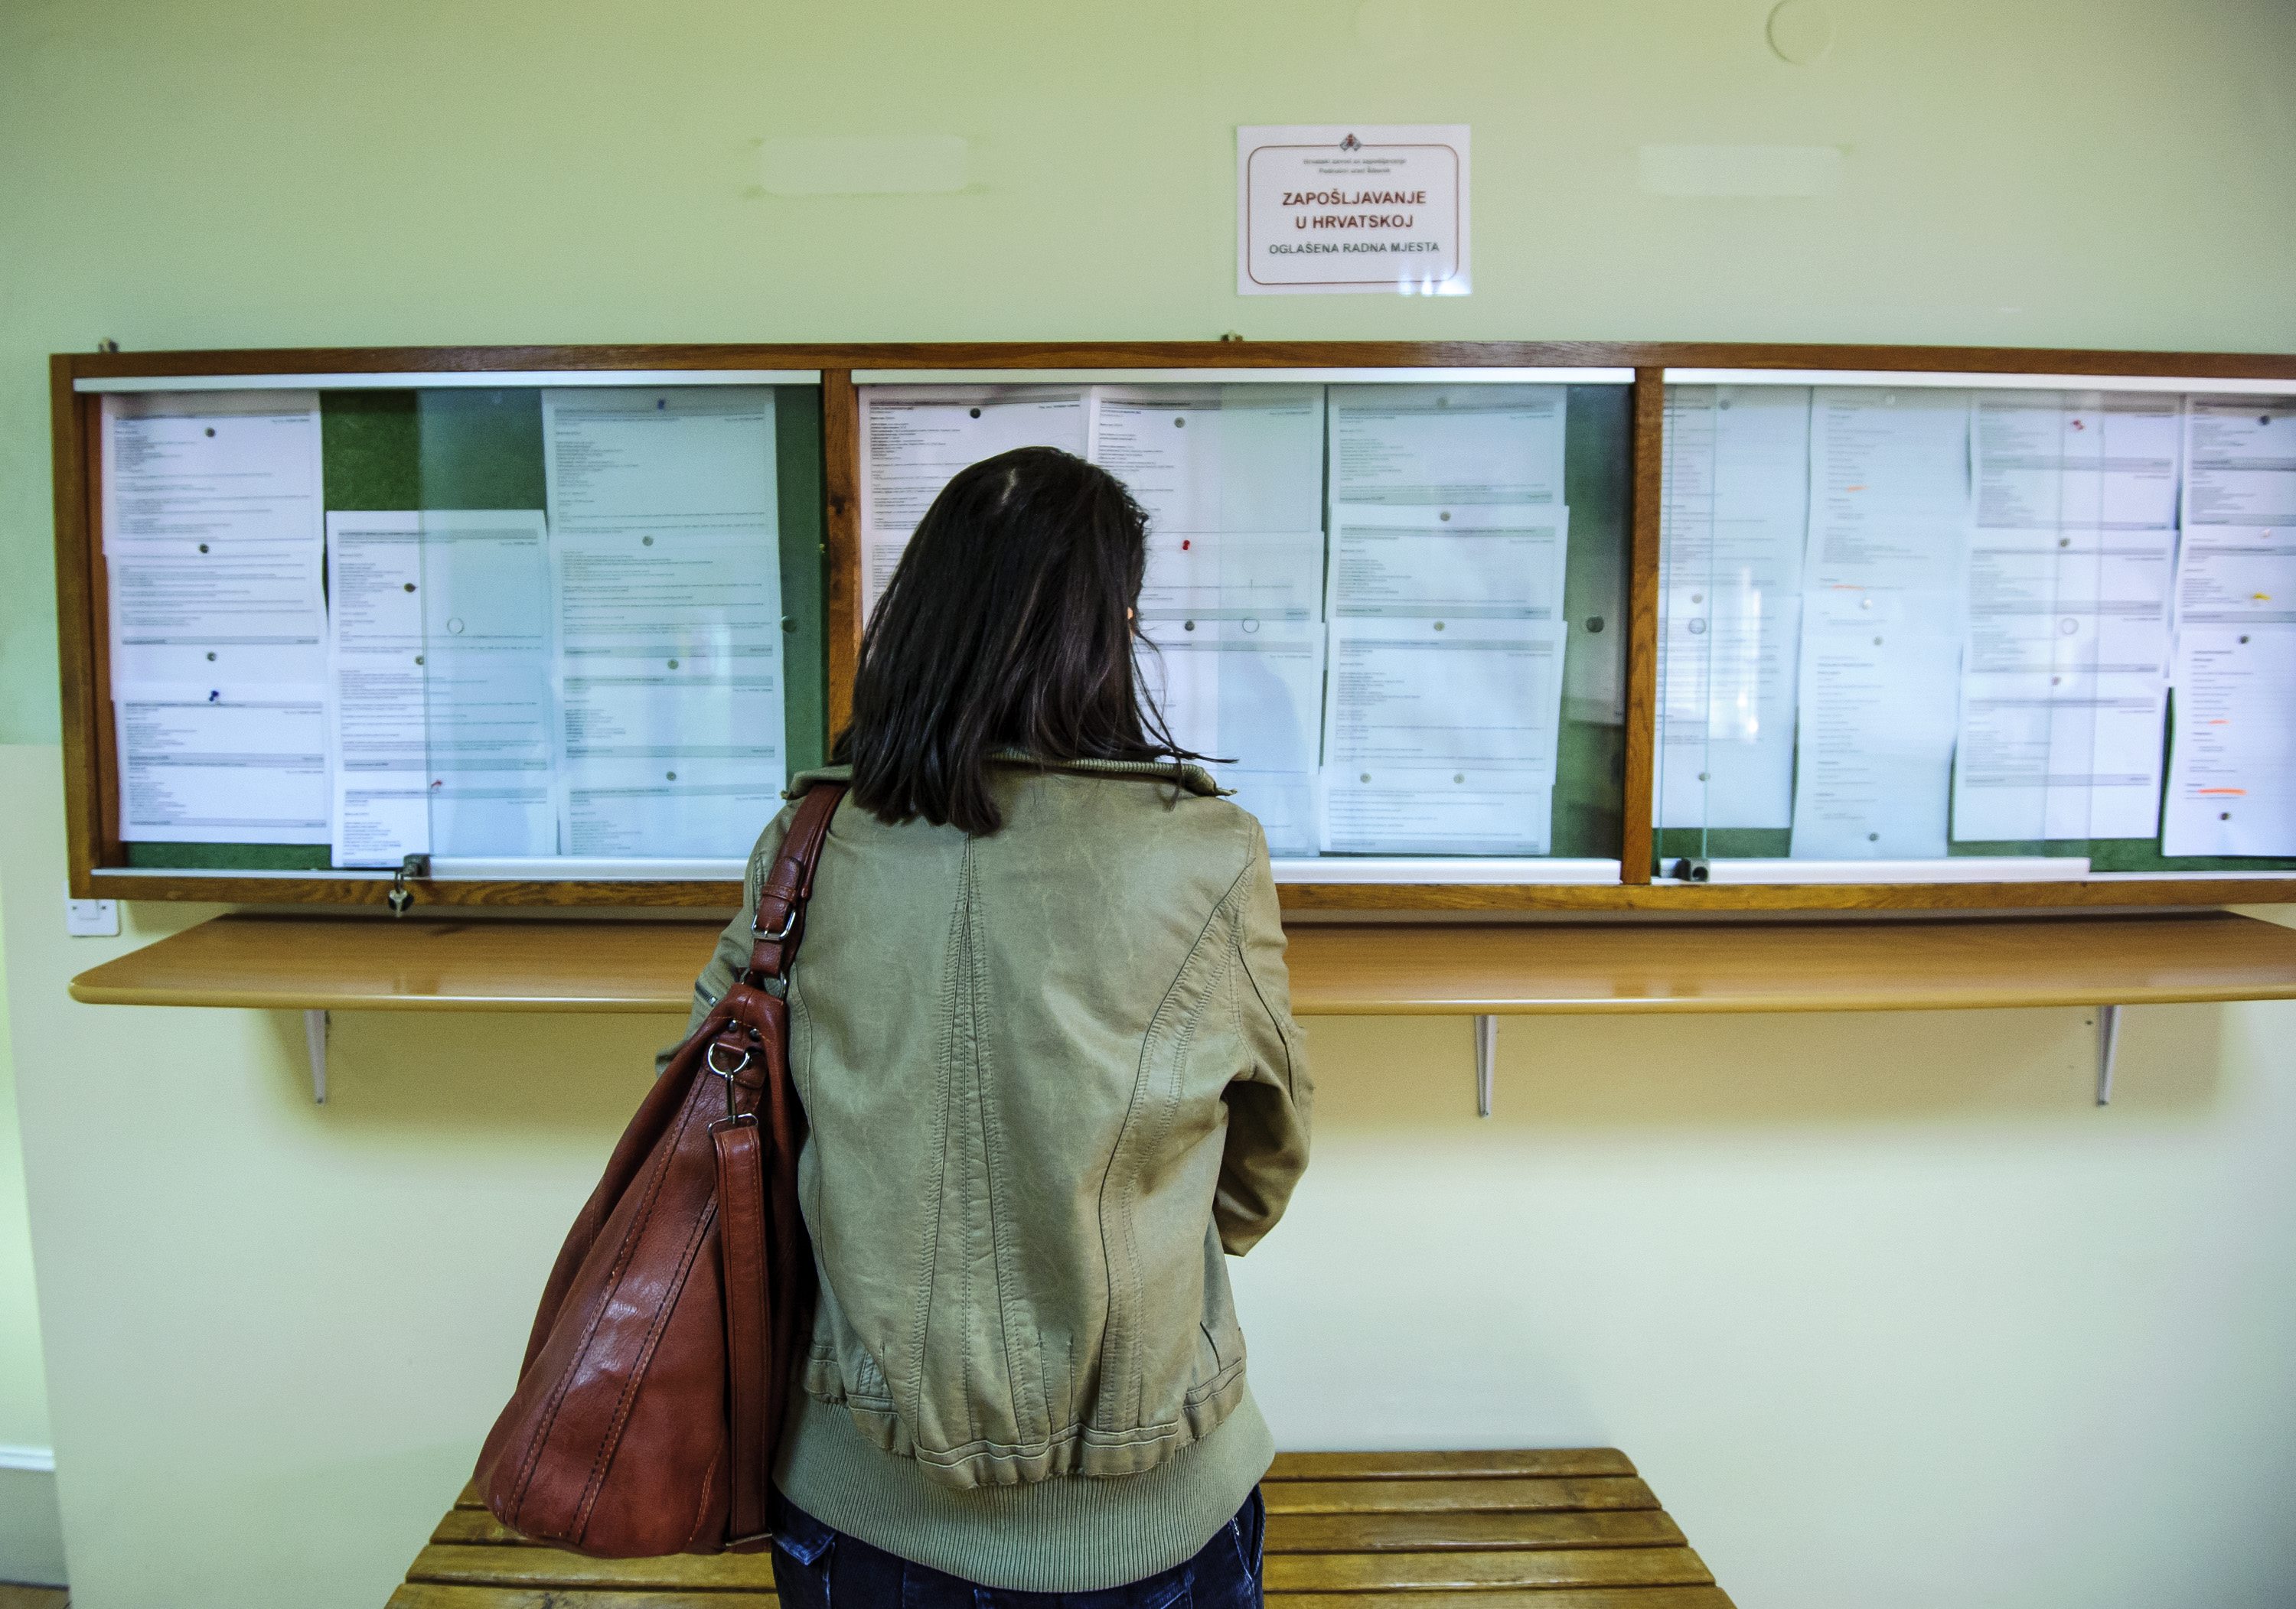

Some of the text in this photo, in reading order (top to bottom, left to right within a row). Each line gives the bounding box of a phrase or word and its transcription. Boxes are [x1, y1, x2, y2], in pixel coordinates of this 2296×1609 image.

[1282, 188, 1427, 206] ZAPOŠLJAVANJE
[1296, 215, 1414, 229] U HRVATSKOJ
[1269, 241, 1440, 254] OGLAŠENA RADNA MJESTA
